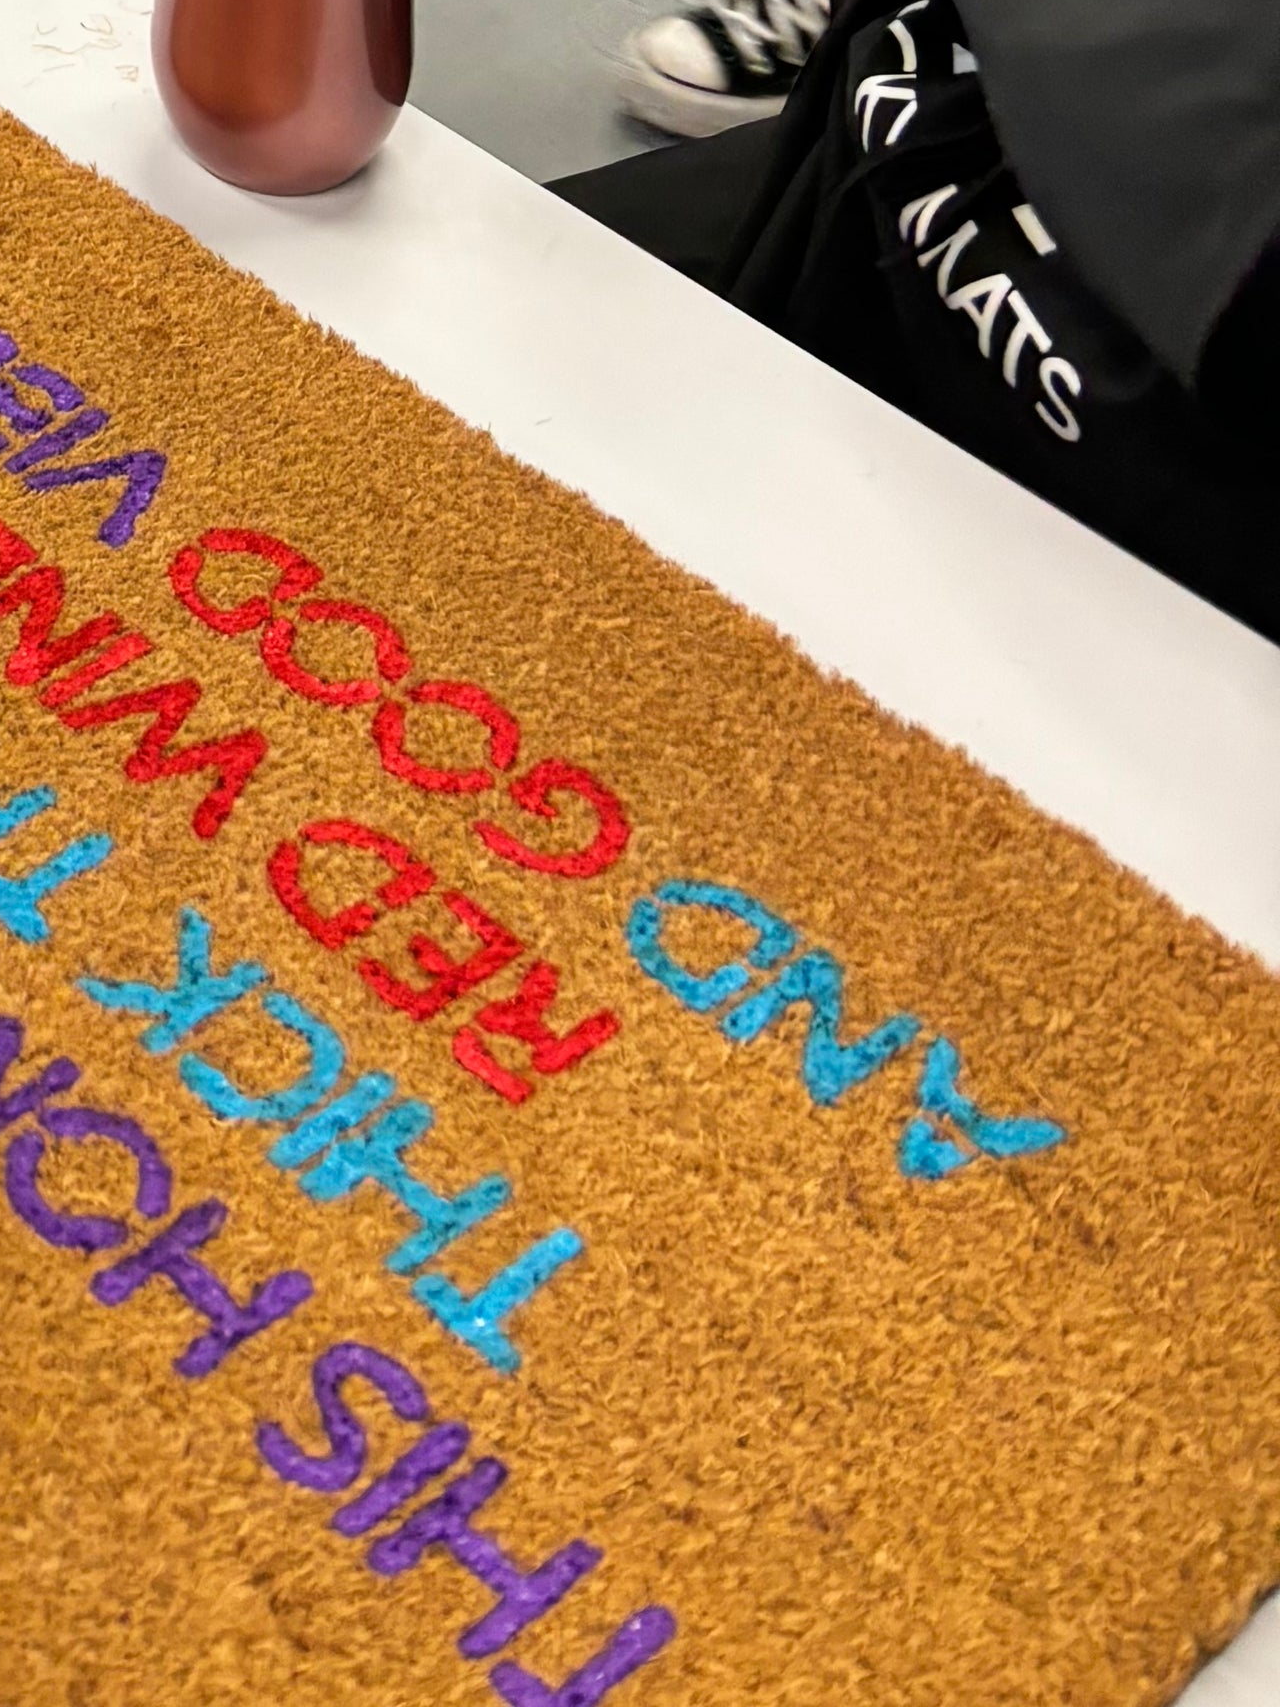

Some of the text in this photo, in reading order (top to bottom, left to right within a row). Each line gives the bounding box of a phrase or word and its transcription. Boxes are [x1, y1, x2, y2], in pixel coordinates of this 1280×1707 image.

[168, 526, 634, 880] GOOD
[268, 818, 622, 1106] RED
[623, 877, 1070, 1181] AND
[77, 906, 586, 1375] THICK
[256, 1339, 678, 1707] THIS
